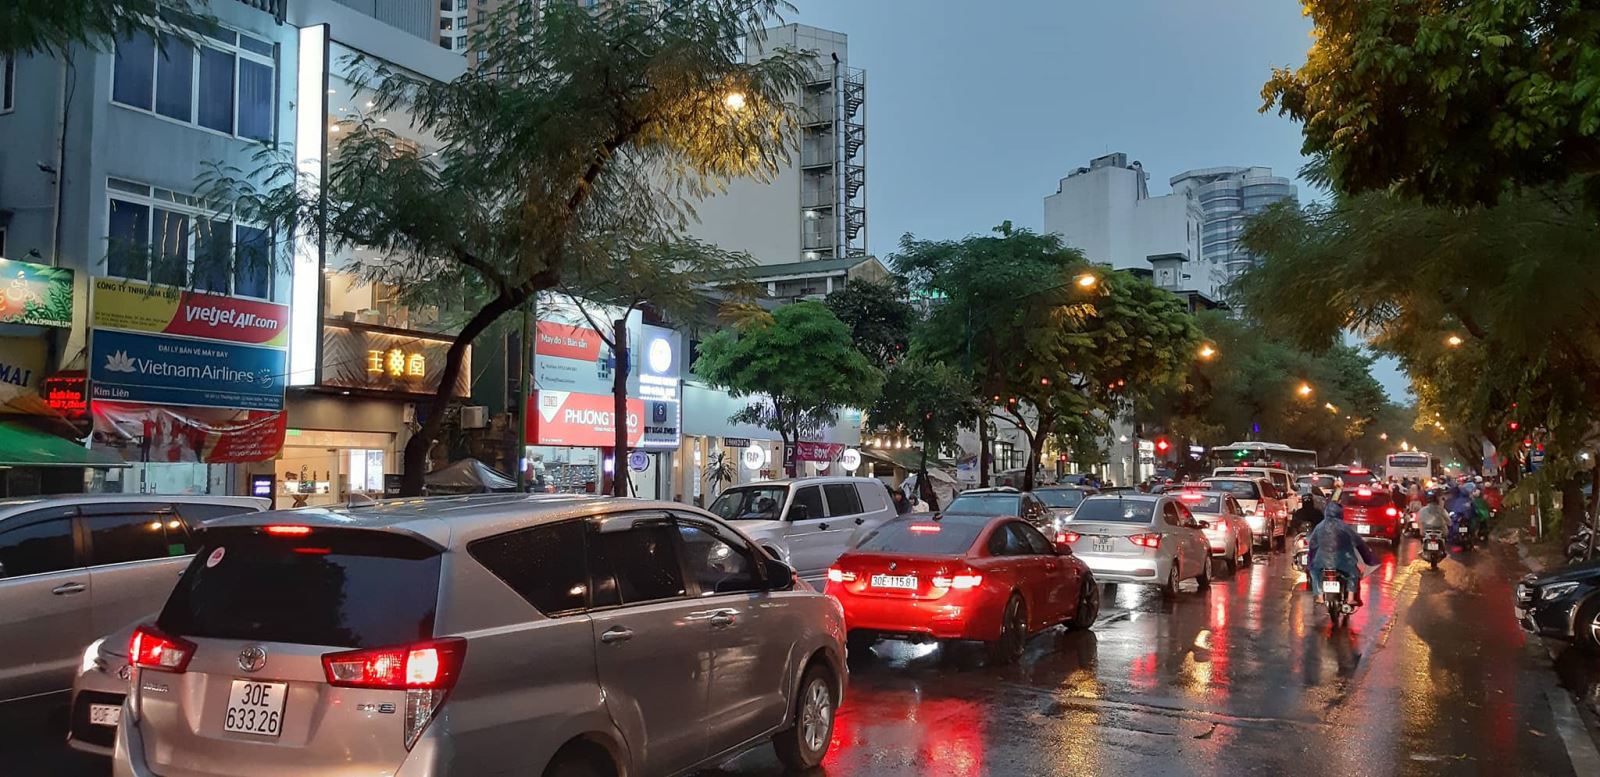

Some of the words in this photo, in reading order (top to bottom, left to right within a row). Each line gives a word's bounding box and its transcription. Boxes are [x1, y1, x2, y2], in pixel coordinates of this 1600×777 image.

[137, 357, 200, 378] Vietnam
[201, 365, 254, 383] Airlines
[93, 386, 110, 397] Kim
[241, 683, 272, 707] 30E
[226, 707, 279, 733] 633.26
